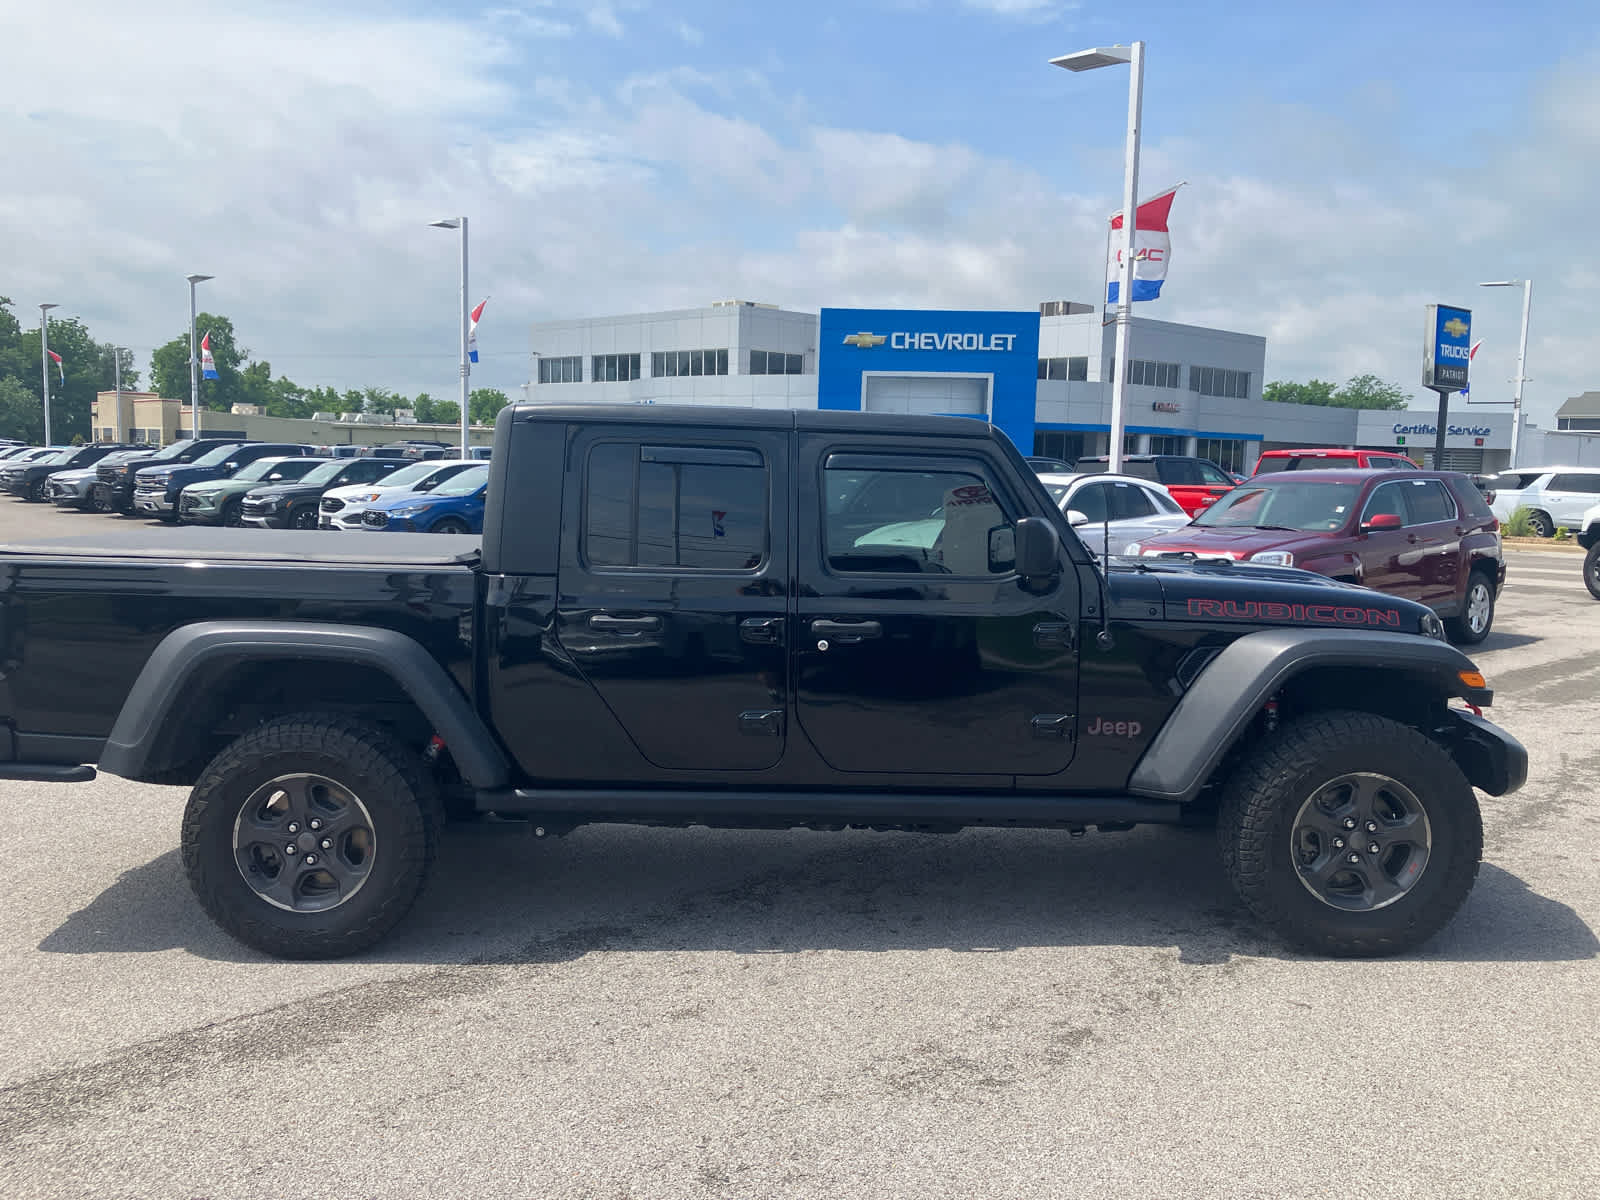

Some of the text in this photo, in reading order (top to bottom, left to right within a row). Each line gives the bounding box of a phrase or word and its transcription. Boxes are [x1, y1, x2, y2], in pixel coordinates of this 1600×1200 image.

[891, 332, 1017, 351] CHEVROLET
[1440, 343, 1469, 360] TRUCKS
[1442, 368, 1465, 380] PATRIOT
[1393, 423, 1490, 436] Certifie Service
[1187, 598, 1401, 626] RUBICON
[1087, 716, 1142, 739] Jeep
